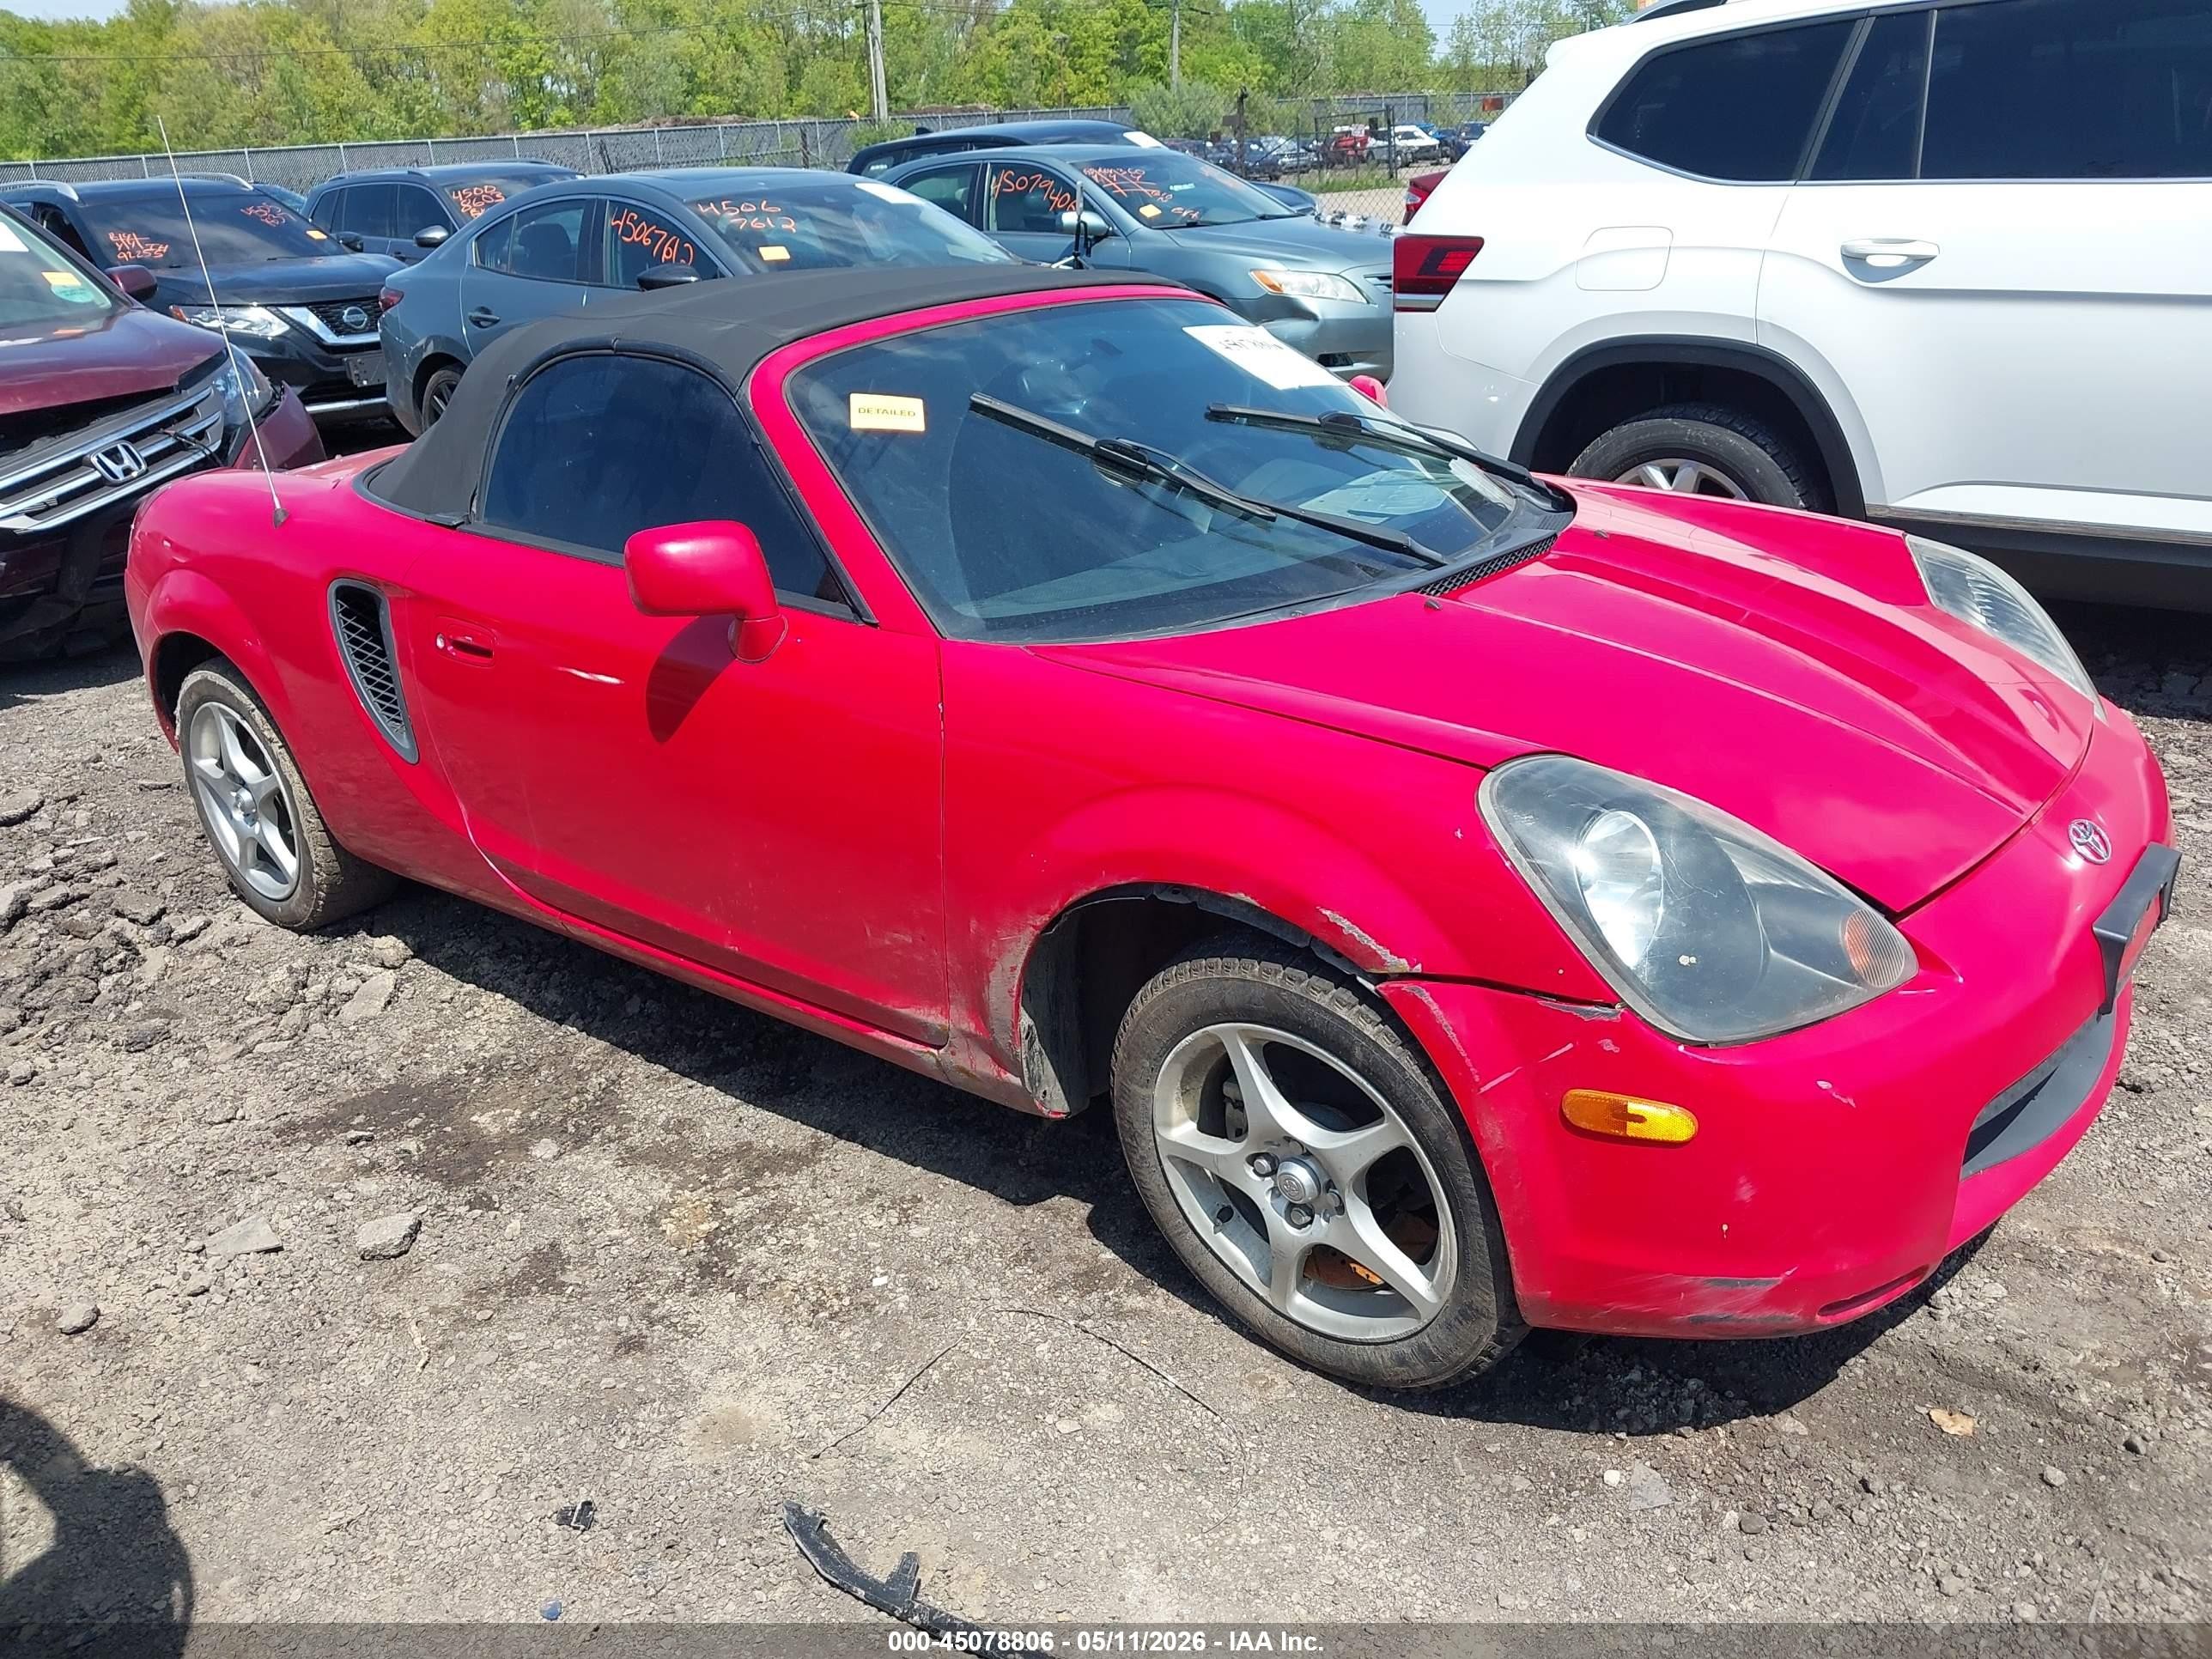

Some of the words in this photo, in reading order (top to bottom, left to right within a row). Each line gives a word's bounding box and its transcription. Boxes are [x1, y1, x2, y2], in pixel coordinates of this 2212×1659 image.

[697, 199, 782, 216] 4506
[730, 217, 797, 234] 7612
[858, 407, 916, 417] DETAILED
